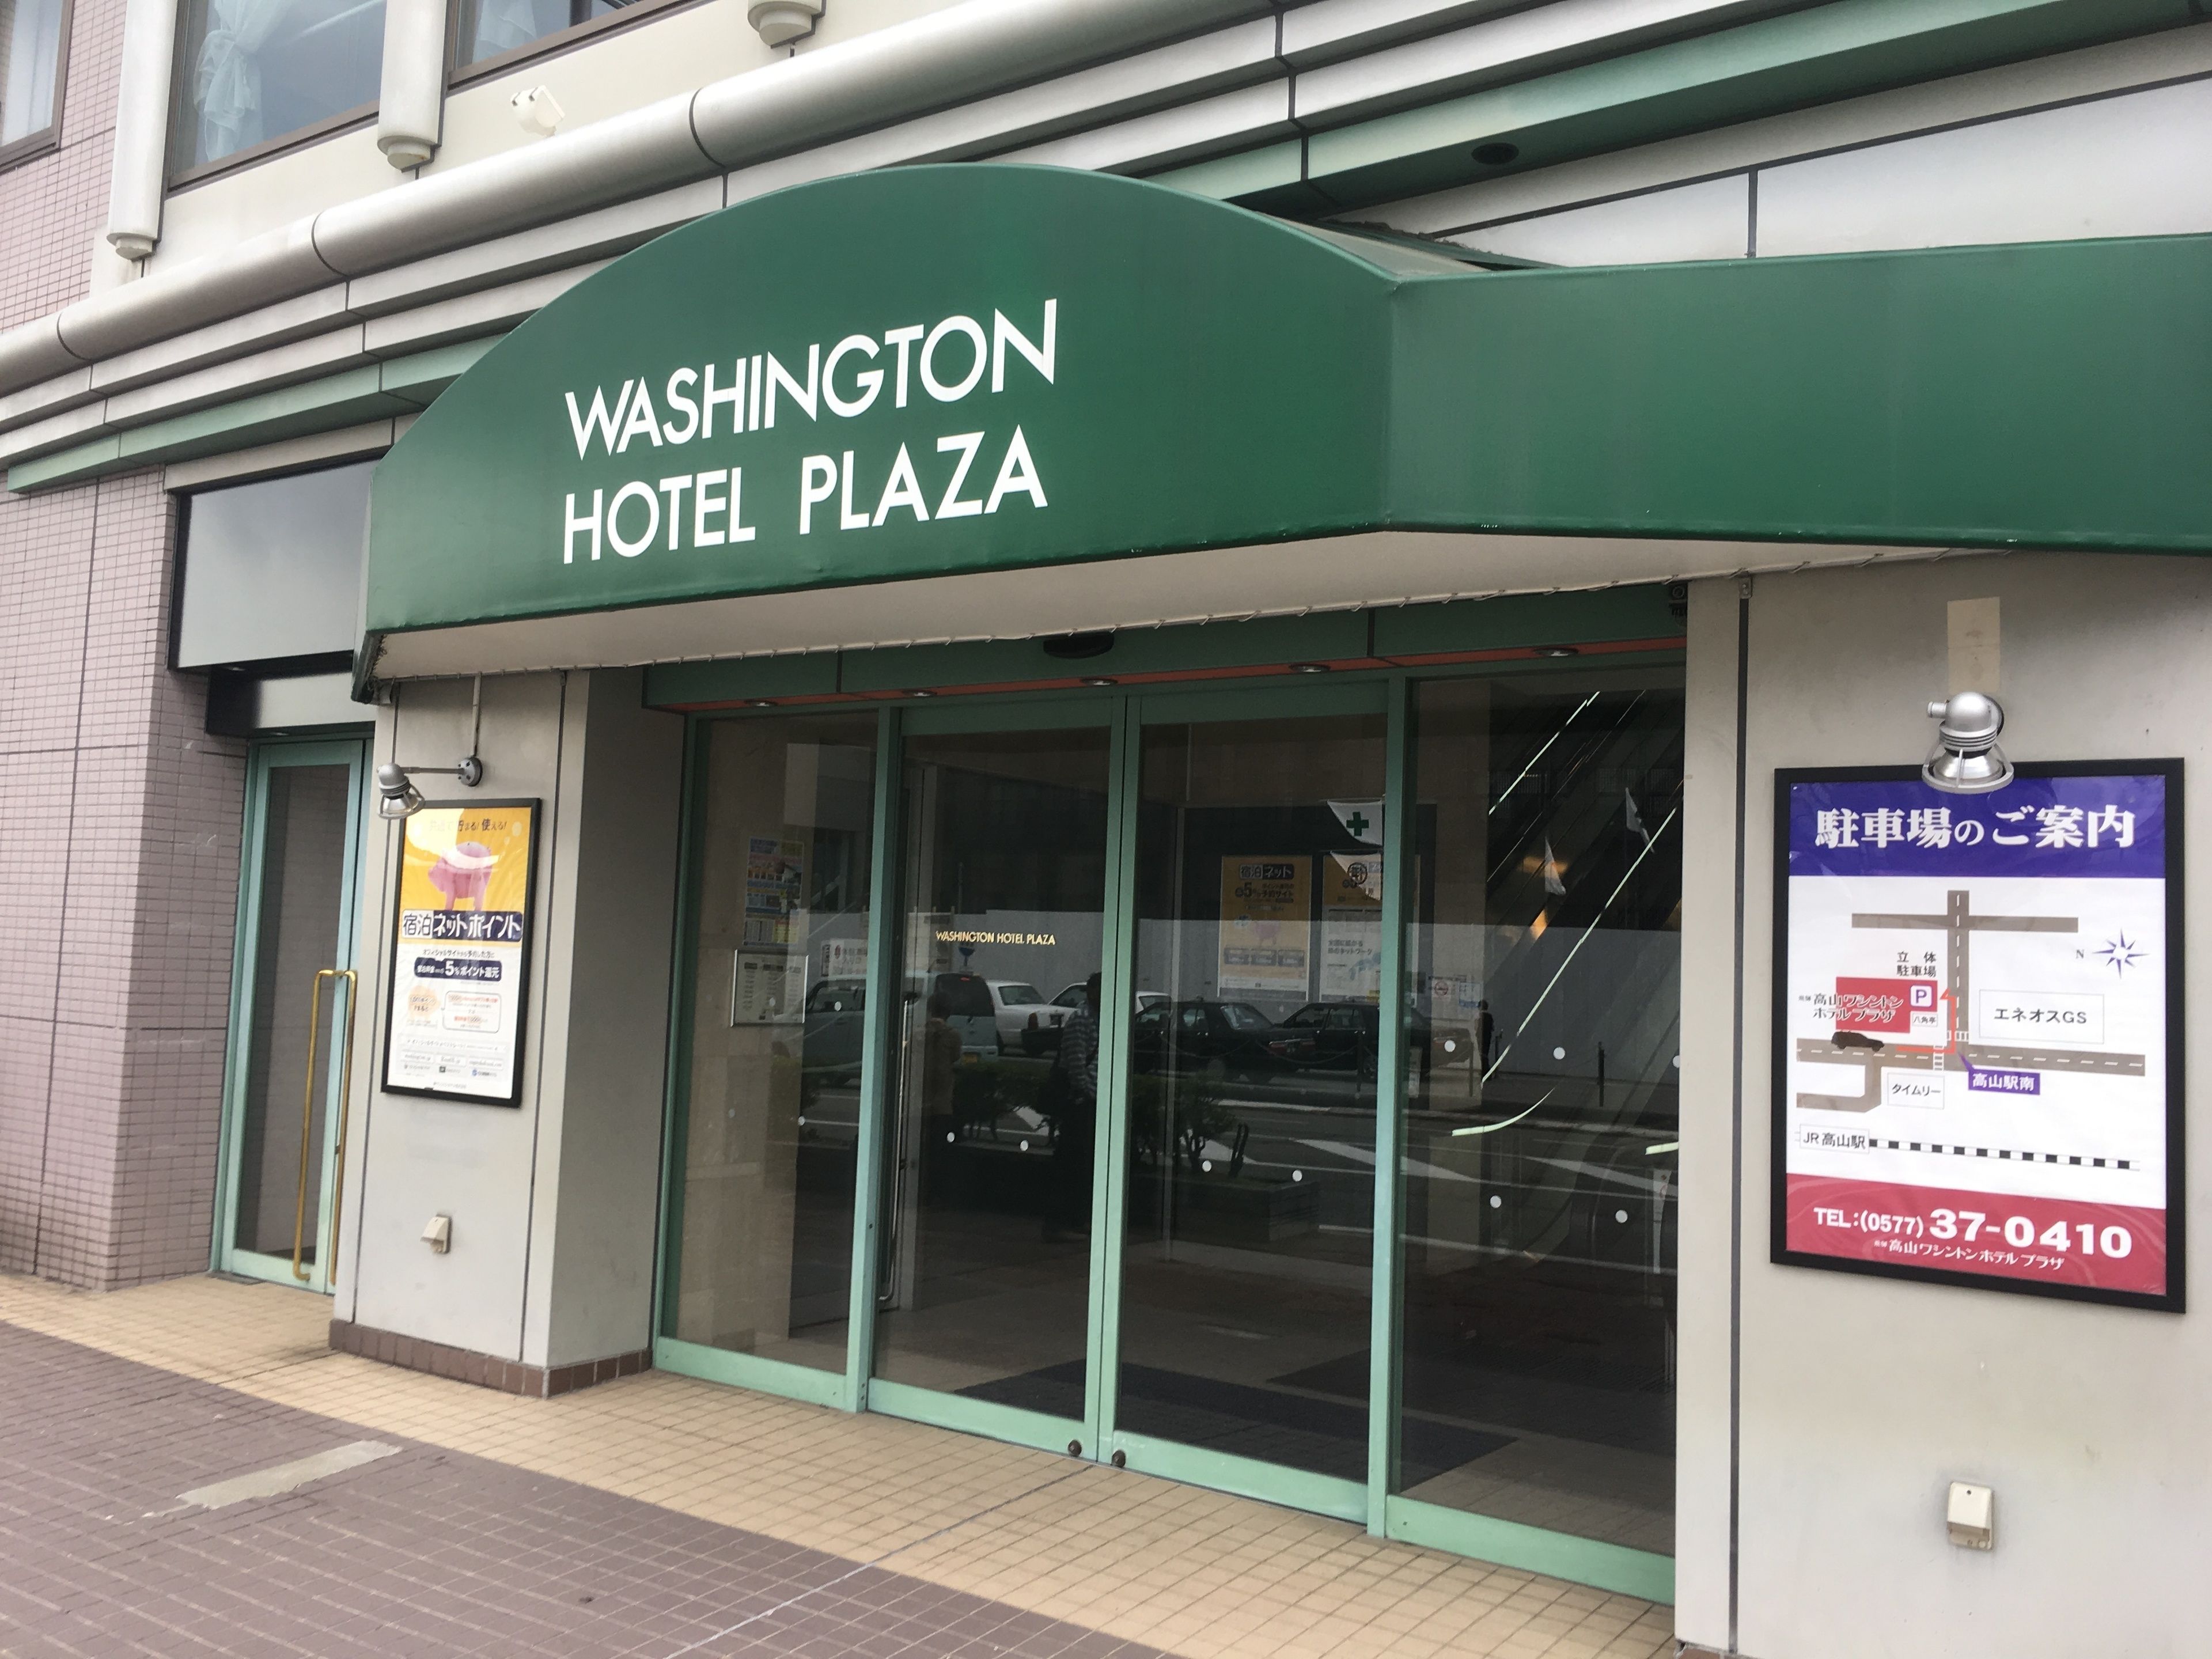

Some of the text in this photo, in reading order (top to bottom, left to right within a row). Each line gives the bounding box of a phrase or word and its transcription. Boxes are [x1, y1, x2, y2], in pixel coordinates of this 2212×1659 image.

[566, 298, 1057, 460] WASHINGTON
[563, 424, 1048, 563] HOTEL PLAZA
[1815, 804, 2135, 849] 駐車場のご案内
[403, 913, 522, 939] 宿泊ネットポイント
[935, 930, 1055, 945] WASHINGTON HOTEL PLAZA
[2075, 949, 2085, 959] N
[1896, 965, 1937, 977] 駐車場
[1915, 989, 1927, 1003] P
[1914, 1016, 1936, 1024] 八角亭
[1994, 1007, 2087, 1024] エネオスGS
[1892, 1084, 1941, 1097] タイムリー
[1972, 1073, 2035, 1091] 高山駅南
[1930, 1207, 2133, 1259] 37-0410
